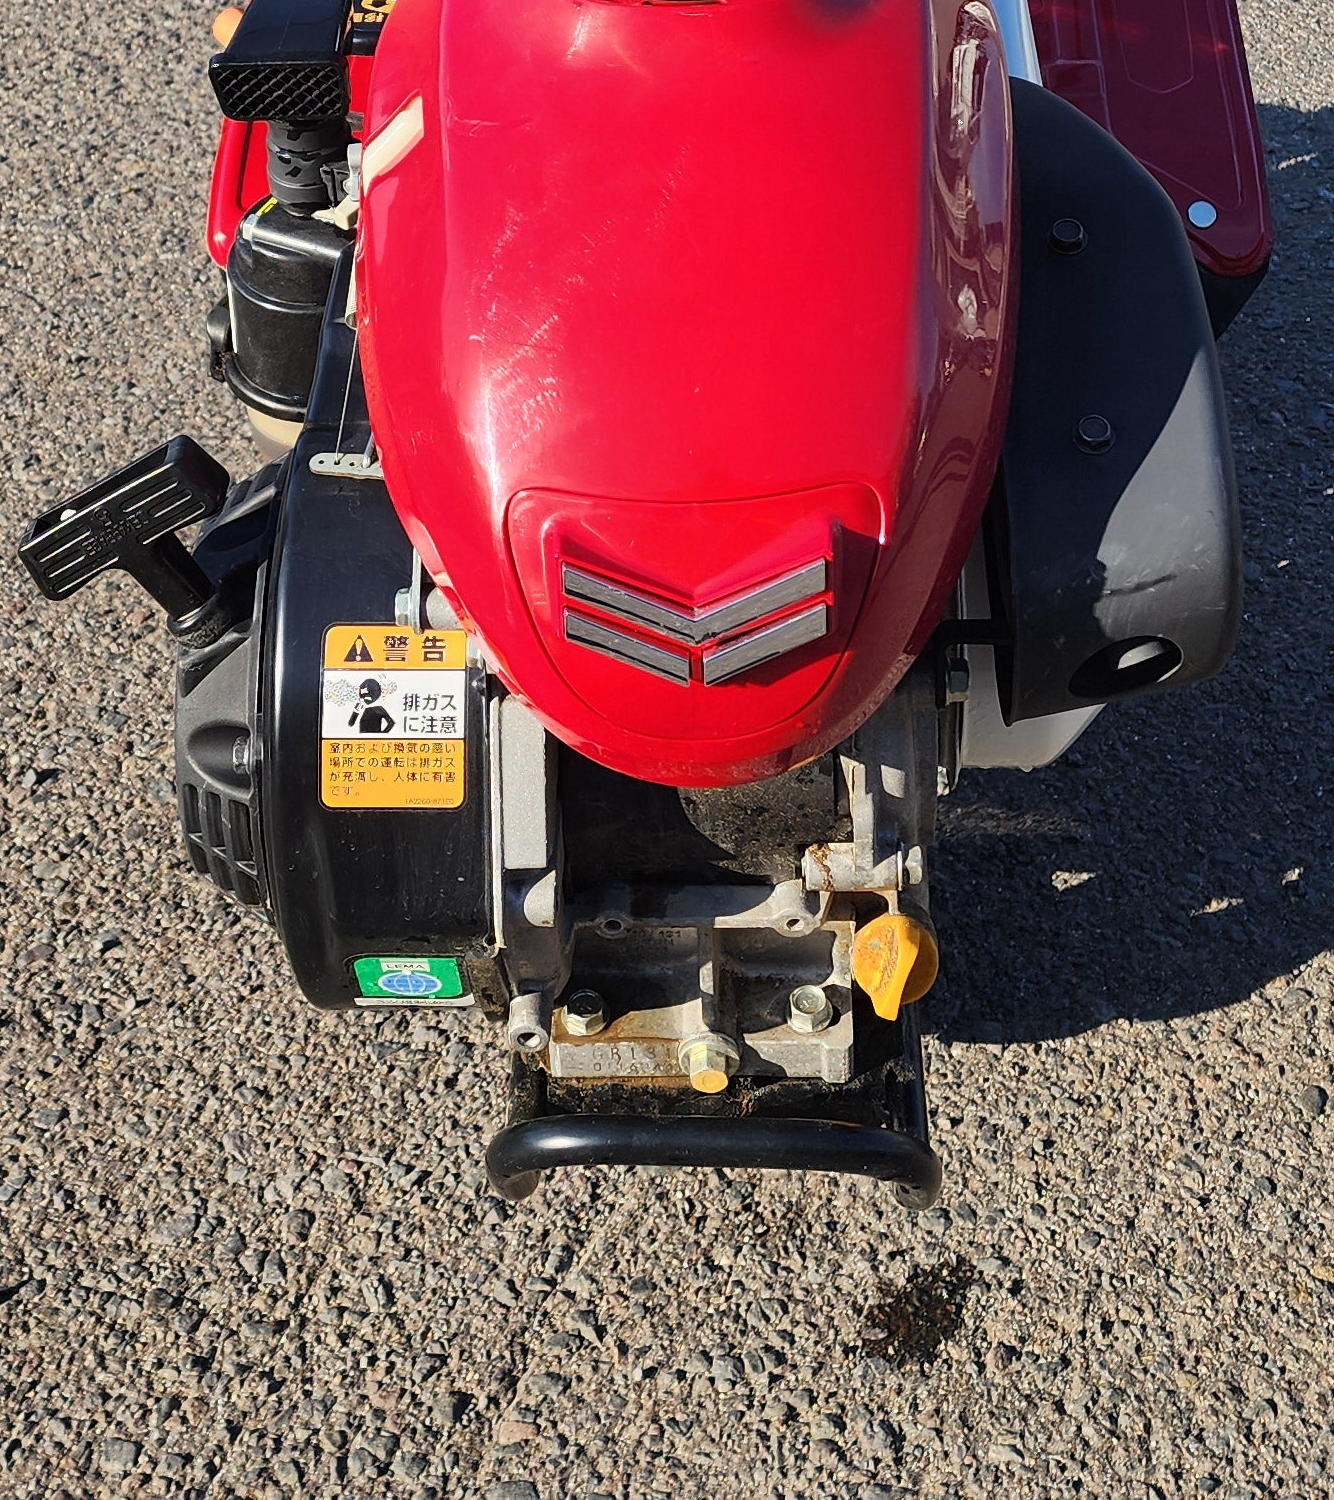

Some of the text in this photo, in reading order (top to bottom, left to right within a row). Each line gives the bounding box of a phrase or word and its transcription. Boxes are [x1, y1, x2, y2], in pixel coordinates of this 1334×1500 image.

[383, 635, 446, 662] 警告
[403, 692, 457, 712] 排ガス
[403, 715, 457, 734] に注意
[329, 742, 456, 754] 室内および換気の悪い
[329, 756, 456, 768] 場所での運転は排ガス
[329, 771, 456, 782] が充満し、人体に有害
[329, 785, 360, 796] です。
